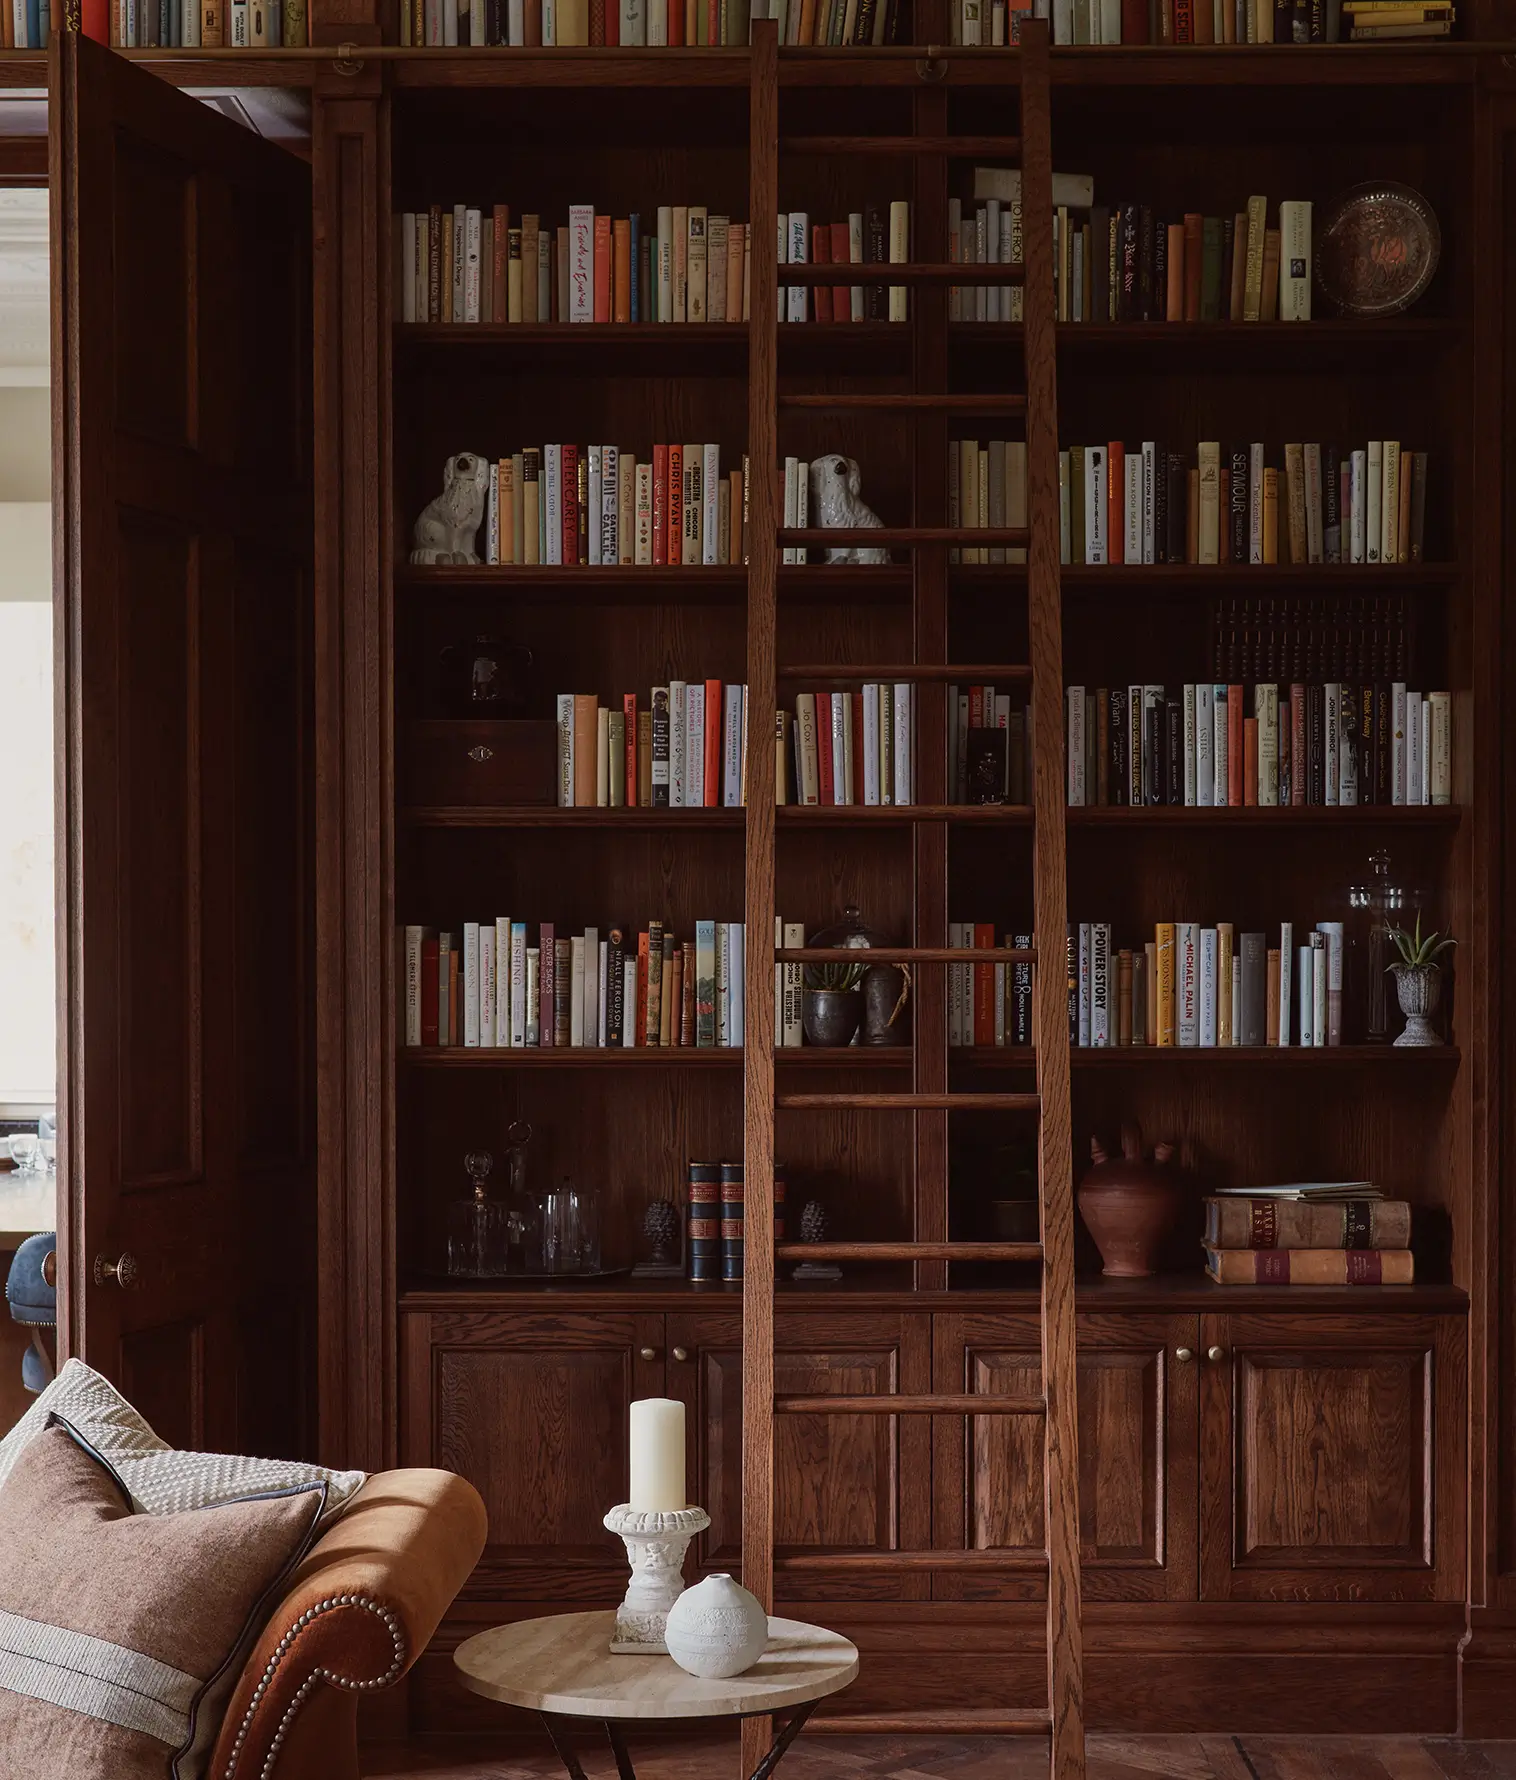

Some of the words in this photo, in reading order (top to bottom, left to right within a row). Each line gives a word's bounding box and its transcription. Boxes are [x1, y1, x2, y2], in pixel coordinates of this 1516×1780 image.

[1013, 204, 1023, 216] TO
[1013, 217, 1023, 233] THE
[574, 224, 589, 256] Friends
[1155, 222, 1165, 272] CENTAUR
[454, 257, 464, 265] by
[454, 266, 464, 287] Design
[1387, 444, 1395, 458] TIM
[563, 449, 576, 486] PETER
[670, 451, 681, 490] CHRIS
[1232, 453, 1247, 513] SEYMOUR
[1327, 469, 1336, 487] TED
[1387, 459, 1395, 489] SEVERIN
[693, 466, 701, 502] ORCHESTRA
[563, 488, 576, 532] CAREY
[670, 493, 681, 526] RYAN
[1252, 483, 1261, 534] Twickenham
[1327, 488, 1336, 523] HUGHES
[602, 513, 610, 556] CALLIL
[609, 513, 617, 557] CARMEN
[802, 709, 812, 721] Jo
[1110, 690, 1122, 726] Lynam
[1328, 696, 1336, 717] JOHN
[1361, 690, 1372, 715] Break
[803, 723, 813, 743] Cox
[1328, 719, 1336, 754] McENROE
[1361, 715, 1372, 739] Away
[560, 729, 572, 760] PERFECT
[545, 937, 554, 966] OLIVER
[614, 950, 622, 976] NIALL
[1094, 930, 1106, 972] POWER
[1185, 944, 1194, 987] MICHAEL
[545, 968, 554, 994] SACKS
[1094, 975, 1106, 1010] STORY
[1161, 958, 1170, 1002] MONSTER
[614, 979, 622, 1028] FERGUSON
[1185, 990, 1194, 1019] PALIN
